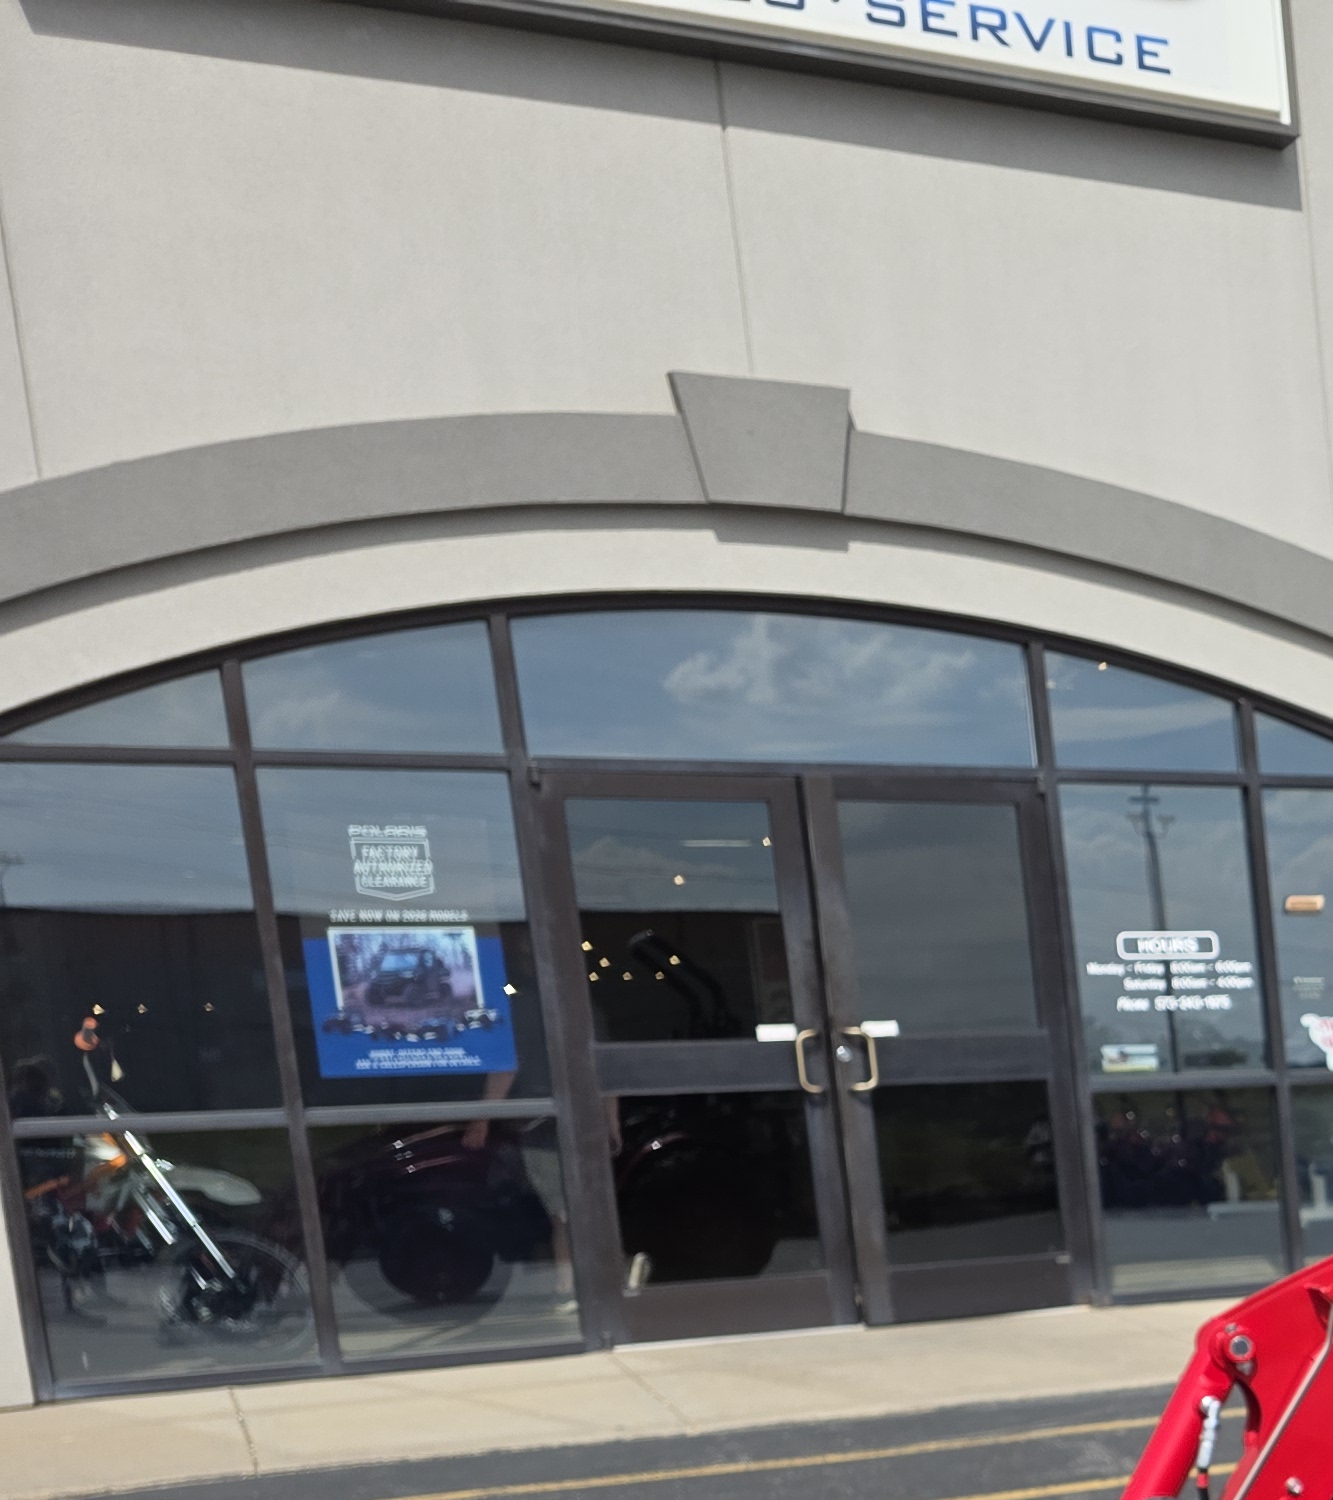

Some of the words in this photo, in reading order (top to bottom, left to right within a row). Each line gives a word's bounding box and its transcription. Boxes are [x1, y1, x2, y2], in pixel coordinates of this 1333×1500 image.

[866, 0, 1172, 75] SERVICE
[347, 824, 428, 837] POLARIS
[361, 845, 418, 859] FACTORY
[353, 859, 434, 875] AUTHORIZED
[361, 874, 429, 888] CLEARANCE
[329, 909, 357, 923] SAVE
[359, 909, 383, 922] NOW
[385, 909, 400, 922] ON
[428, 909, 469, 922] MODELS
[1137, 936, 1200, 954] HOURS
[1086, 962, 1125, 977] Monday
[1134, 961, 1165, 976] Friday
[1123, 977, 1167, 992] Saturday
